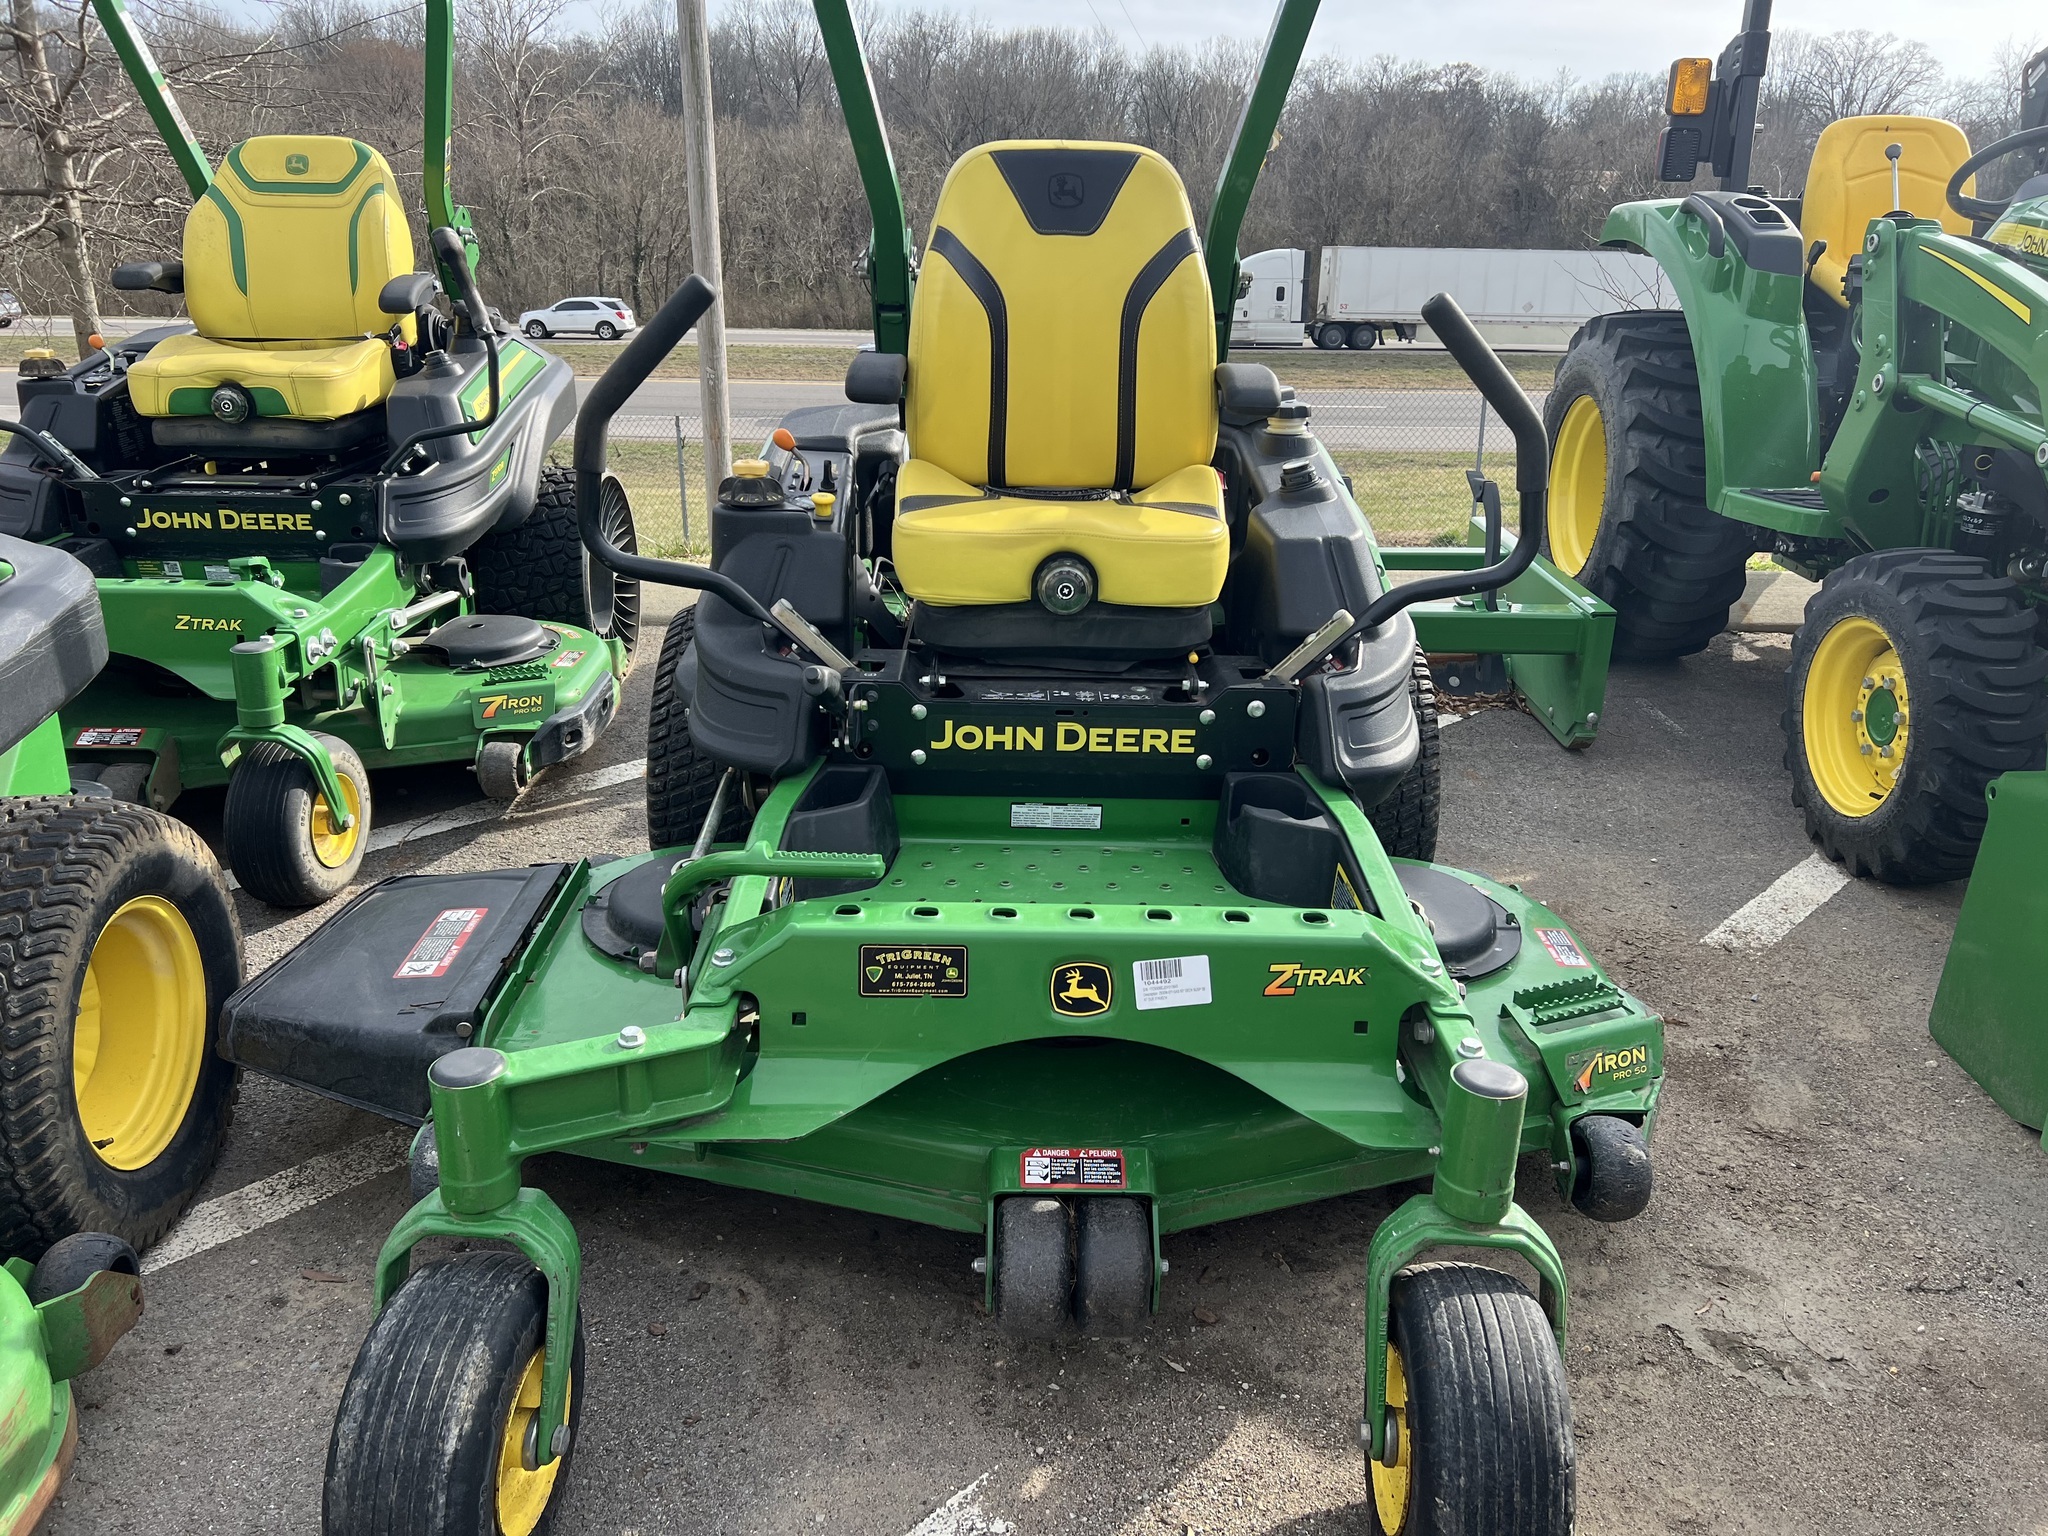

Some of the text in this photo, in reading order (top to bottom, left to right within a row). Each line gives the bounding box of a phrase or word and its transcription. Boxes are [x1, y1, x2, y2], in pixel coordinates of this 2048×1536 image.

[2017, 230, 2047, 255] JOHN
[136, 508, 313, 531] JOHN DEERE
[174, 614, 244, 632] ZTRAK
[930, 720, 1197, 754] JOHN DEERE
[1143, 978, 1172, 986] 1044492
[1263, 963, 1367, 996] ZTRAK
[1612, 1069, 1632, 1081] PRO
[1089, 1149, 1117, 1157] PELIGRO
